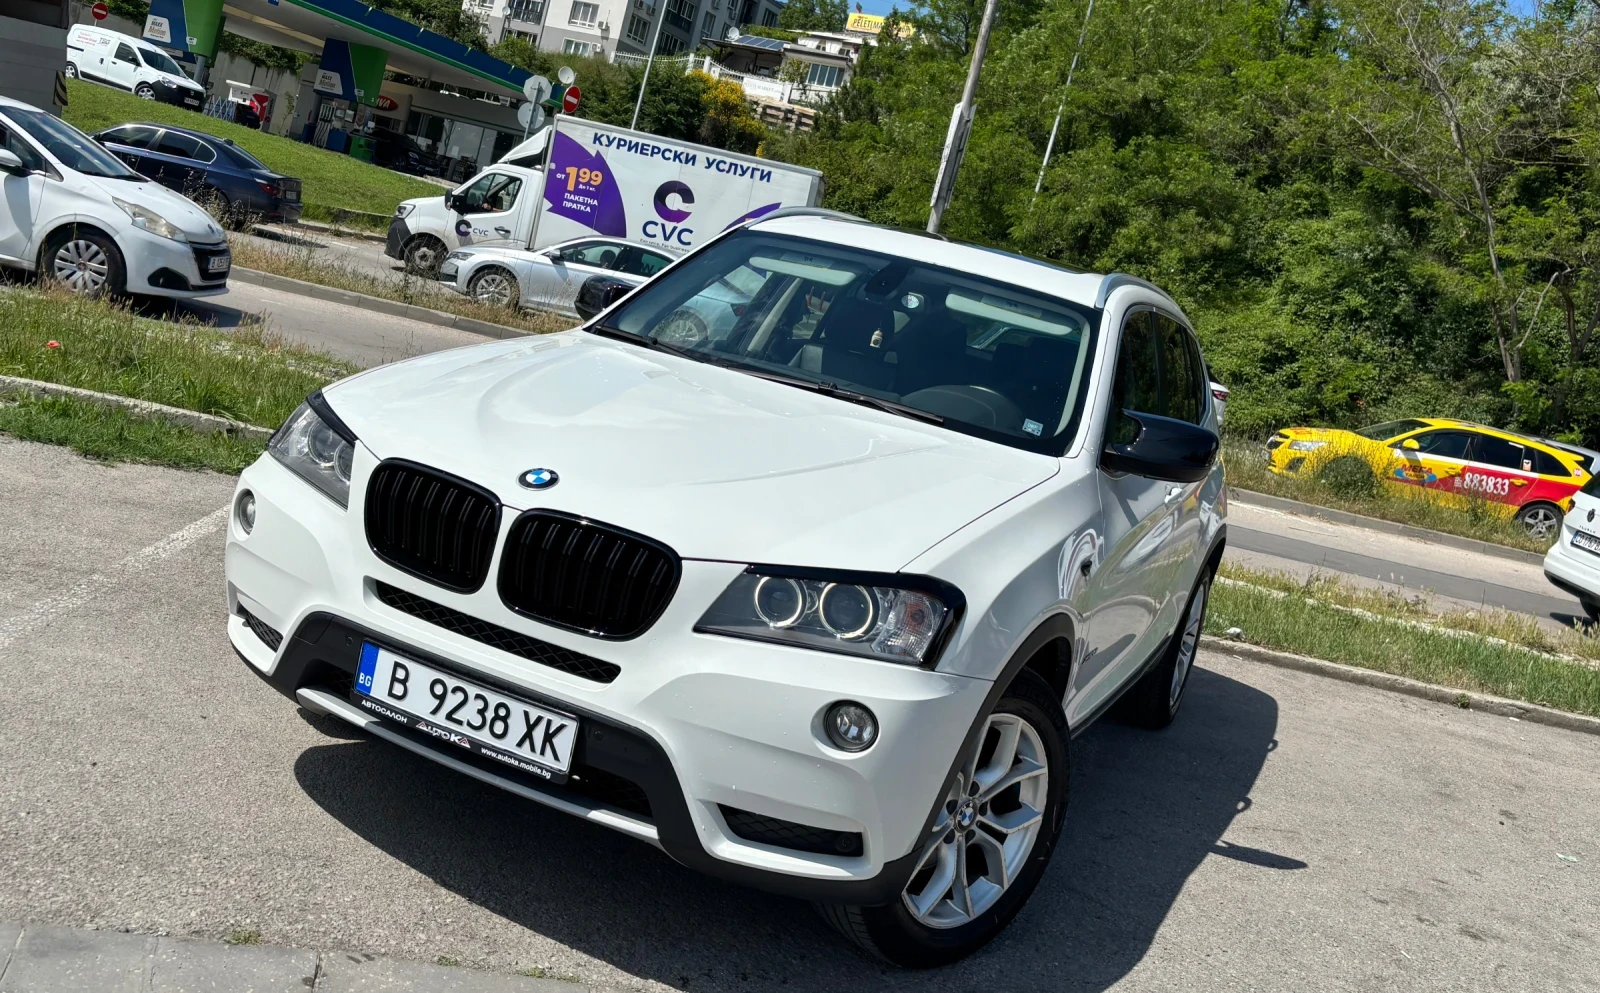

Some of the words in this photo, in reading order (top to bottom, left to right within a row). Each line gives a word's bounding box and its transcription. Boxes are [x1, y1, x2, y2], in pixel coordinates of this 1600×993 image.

[593, 132, 697, 166] КУРИЕРСКИ
[705, 157, 772, 183] УСЛУГИ
[563, 201, 591, 212] ПРАТКА
[564, 193, 598, 205] ПАКЕТНА
[473, 228, 488, 236] CVC
[642, 220, 693, 245] CVC
[1401, 463, 1432, 474] МЕГА
[1463, 472, 1509, 495] 883833
[359, 673, 372, 687] BG
[361, 700, 408, 723] АВТОСАЛОН
[387, 661, 410, 701] B
[429, 678, 511, 739] 9238
[516, 710, 568, 762] XK
[481, 747, 551, 779] www.autoka.mobile.bg
